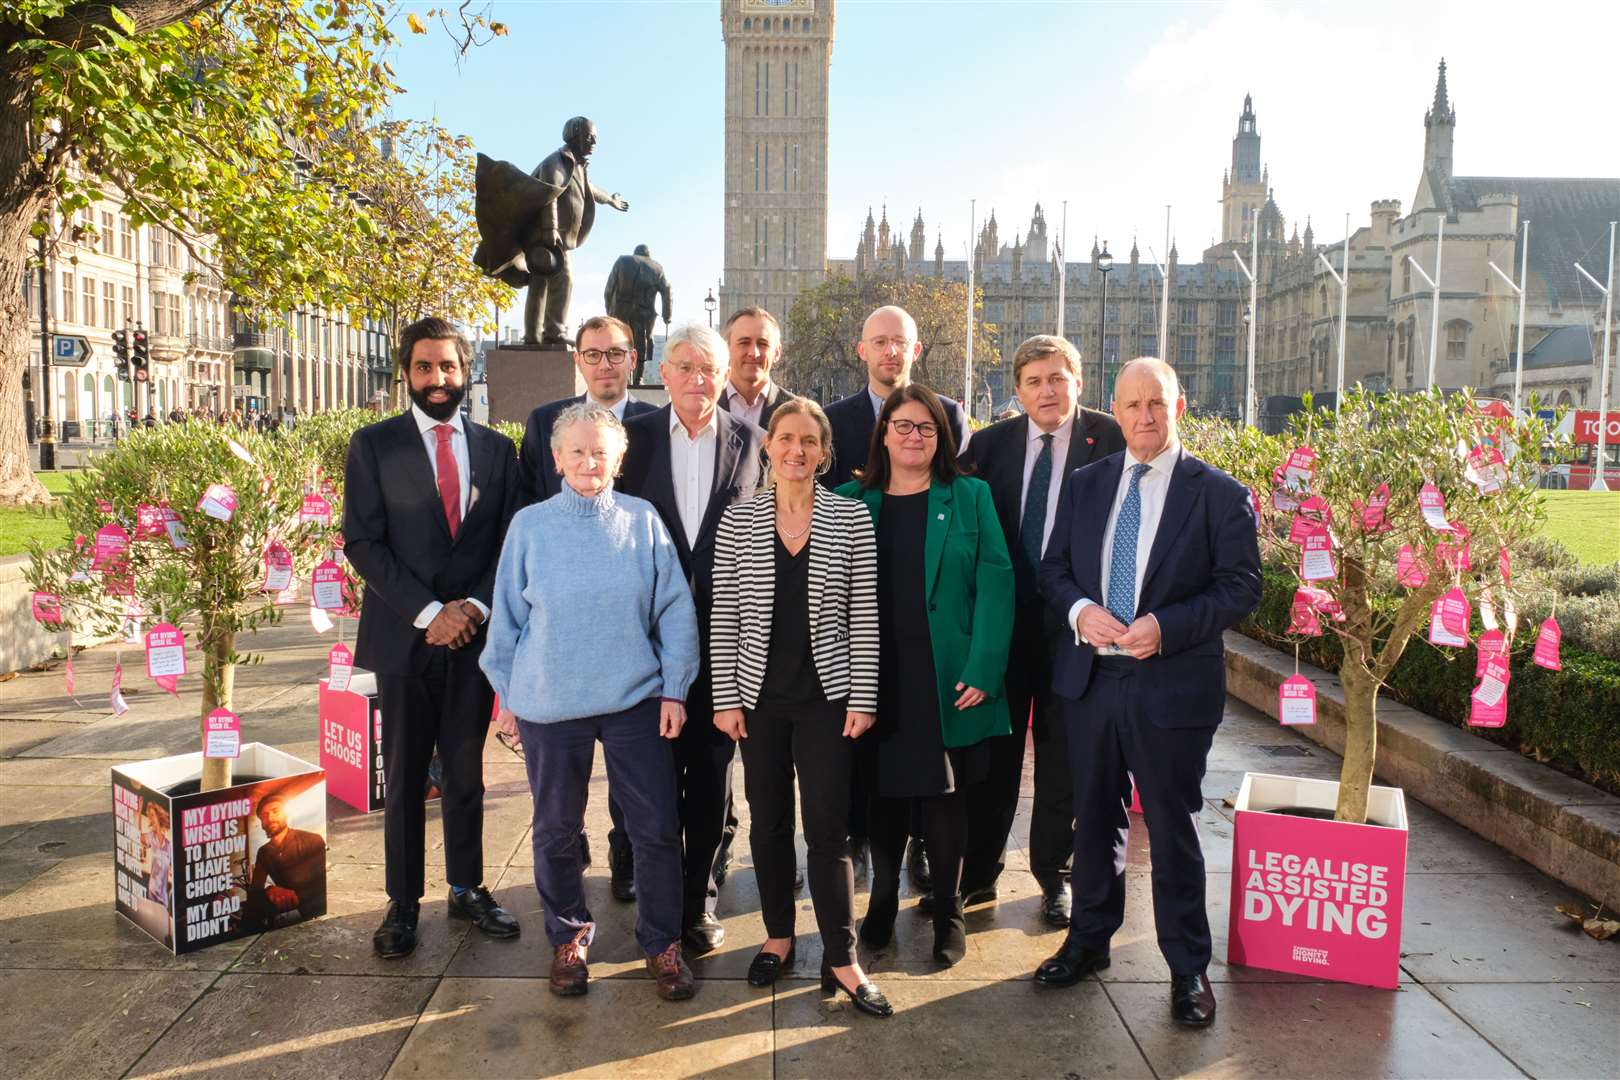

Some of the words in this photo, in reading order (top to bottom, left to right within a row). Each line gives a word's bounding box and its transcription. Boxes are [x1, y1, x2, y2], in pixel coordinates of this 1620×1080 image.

[60, 340, 72, 355] P
[324, 719, 344, 743] LET
[347, 728, 362, 751] US
[324, 737, 363, 769] CHOOSE
[184, 806, 206, 827] MY
[210, 798, 251, 820] DYING
[184, 821, 221, 846] WISH
[224, 819, 238, 836] IS
[184, 845, 202, 864] TO
[206, 834, 247, 859] KNOW
[185, 864, 191, 882] I
[195, 855, 231, 880] HAVE
[1248, 849, 1388, 886] LEGALISE
[186, 873, 234, 899] CHOICE
[1246, 870, 1388, 907] ASSISTED
[186, 902, 209, 925] MY
[212, 896, 240, 919] DAD
[1244, 889, 1388, 939] DYING
